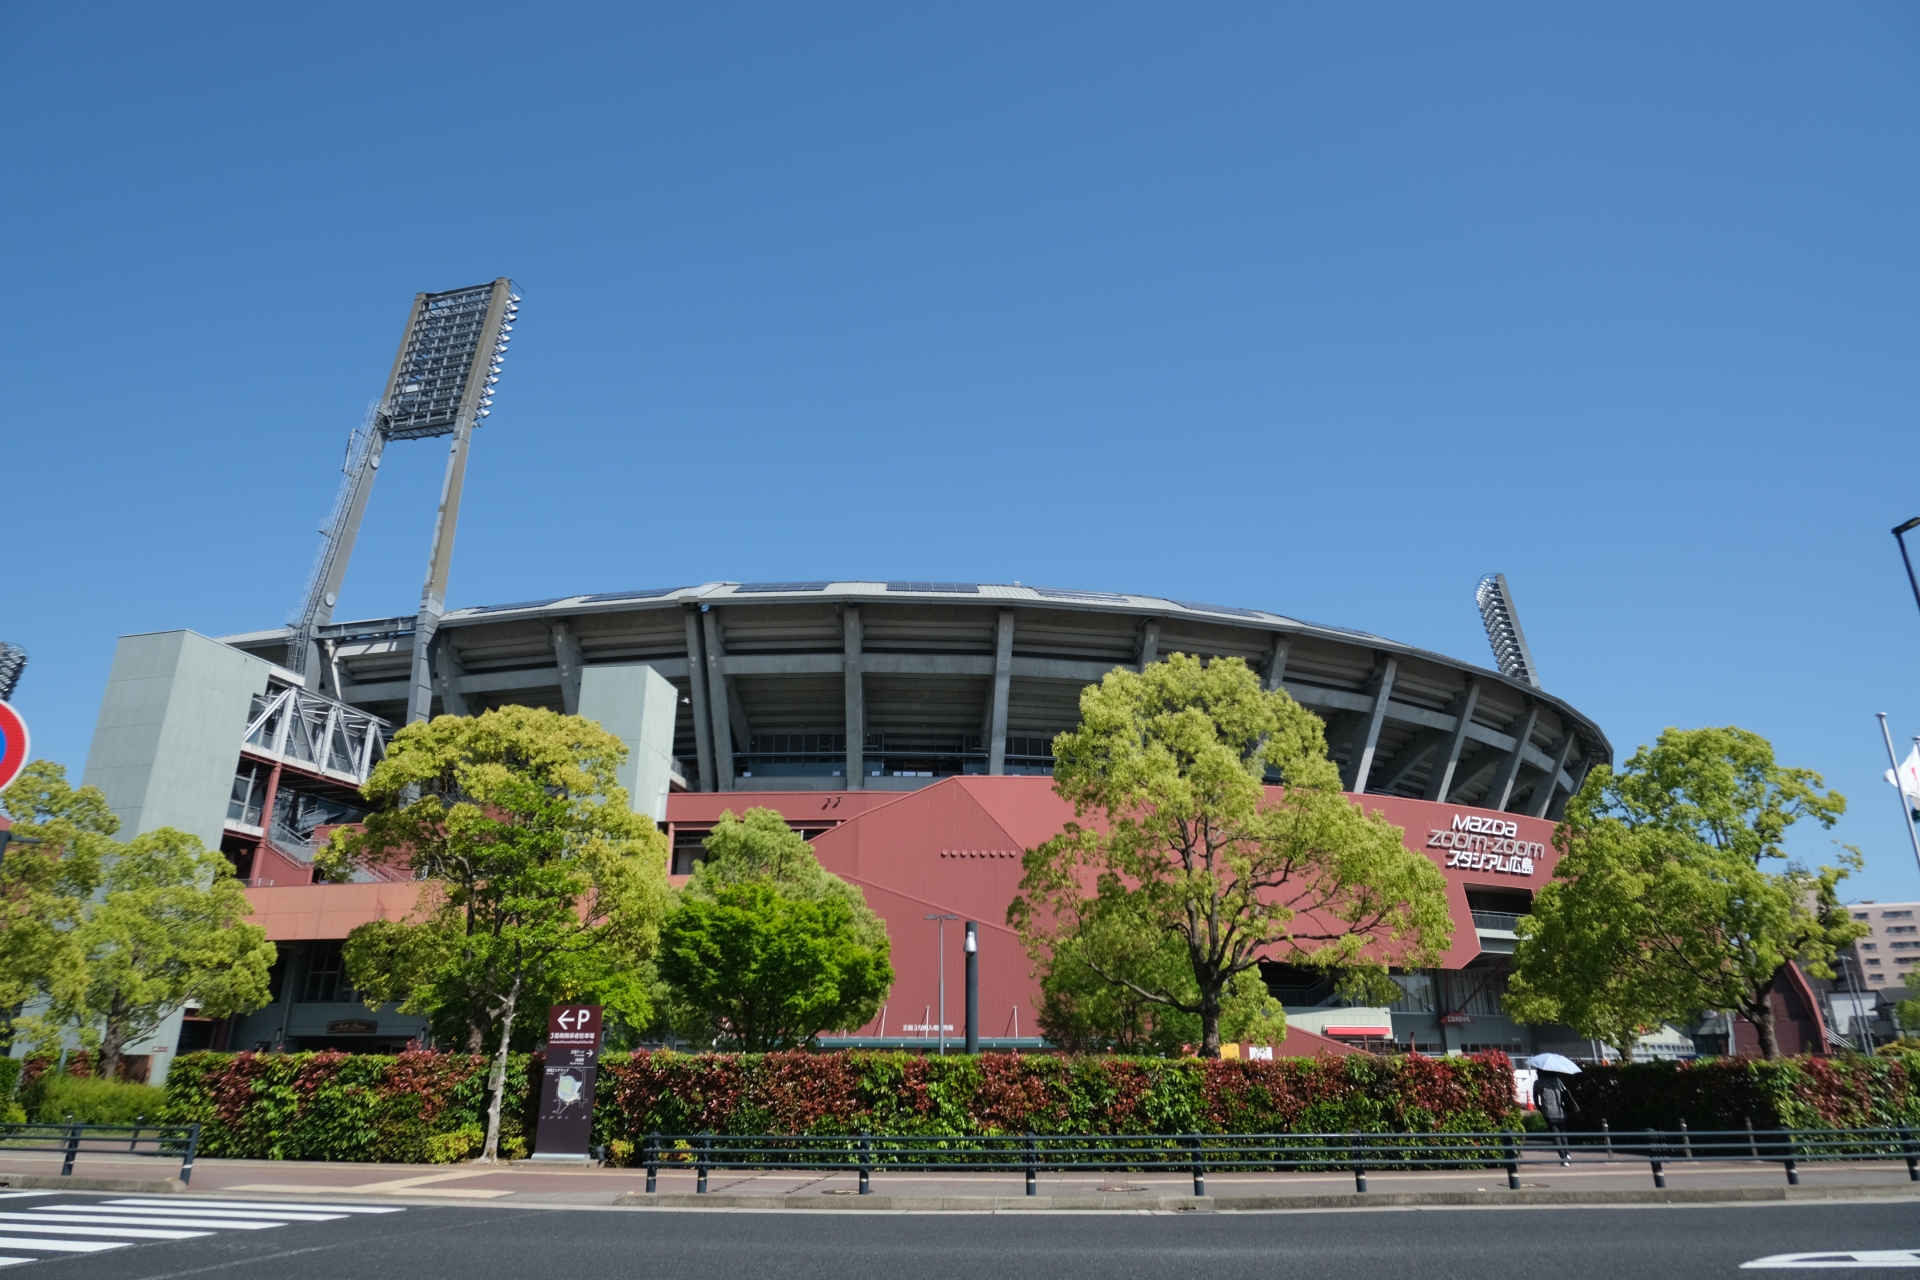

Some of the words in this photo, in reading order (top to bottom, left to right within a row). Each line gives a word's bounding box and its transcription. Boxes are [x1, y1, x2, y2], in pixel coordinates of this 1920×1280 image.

[1428, 829, 1545, 859] zoom-zoom
[1447, 850, 1534, 875] スタジアム広島
[577, 1009, 591, 1030] P
